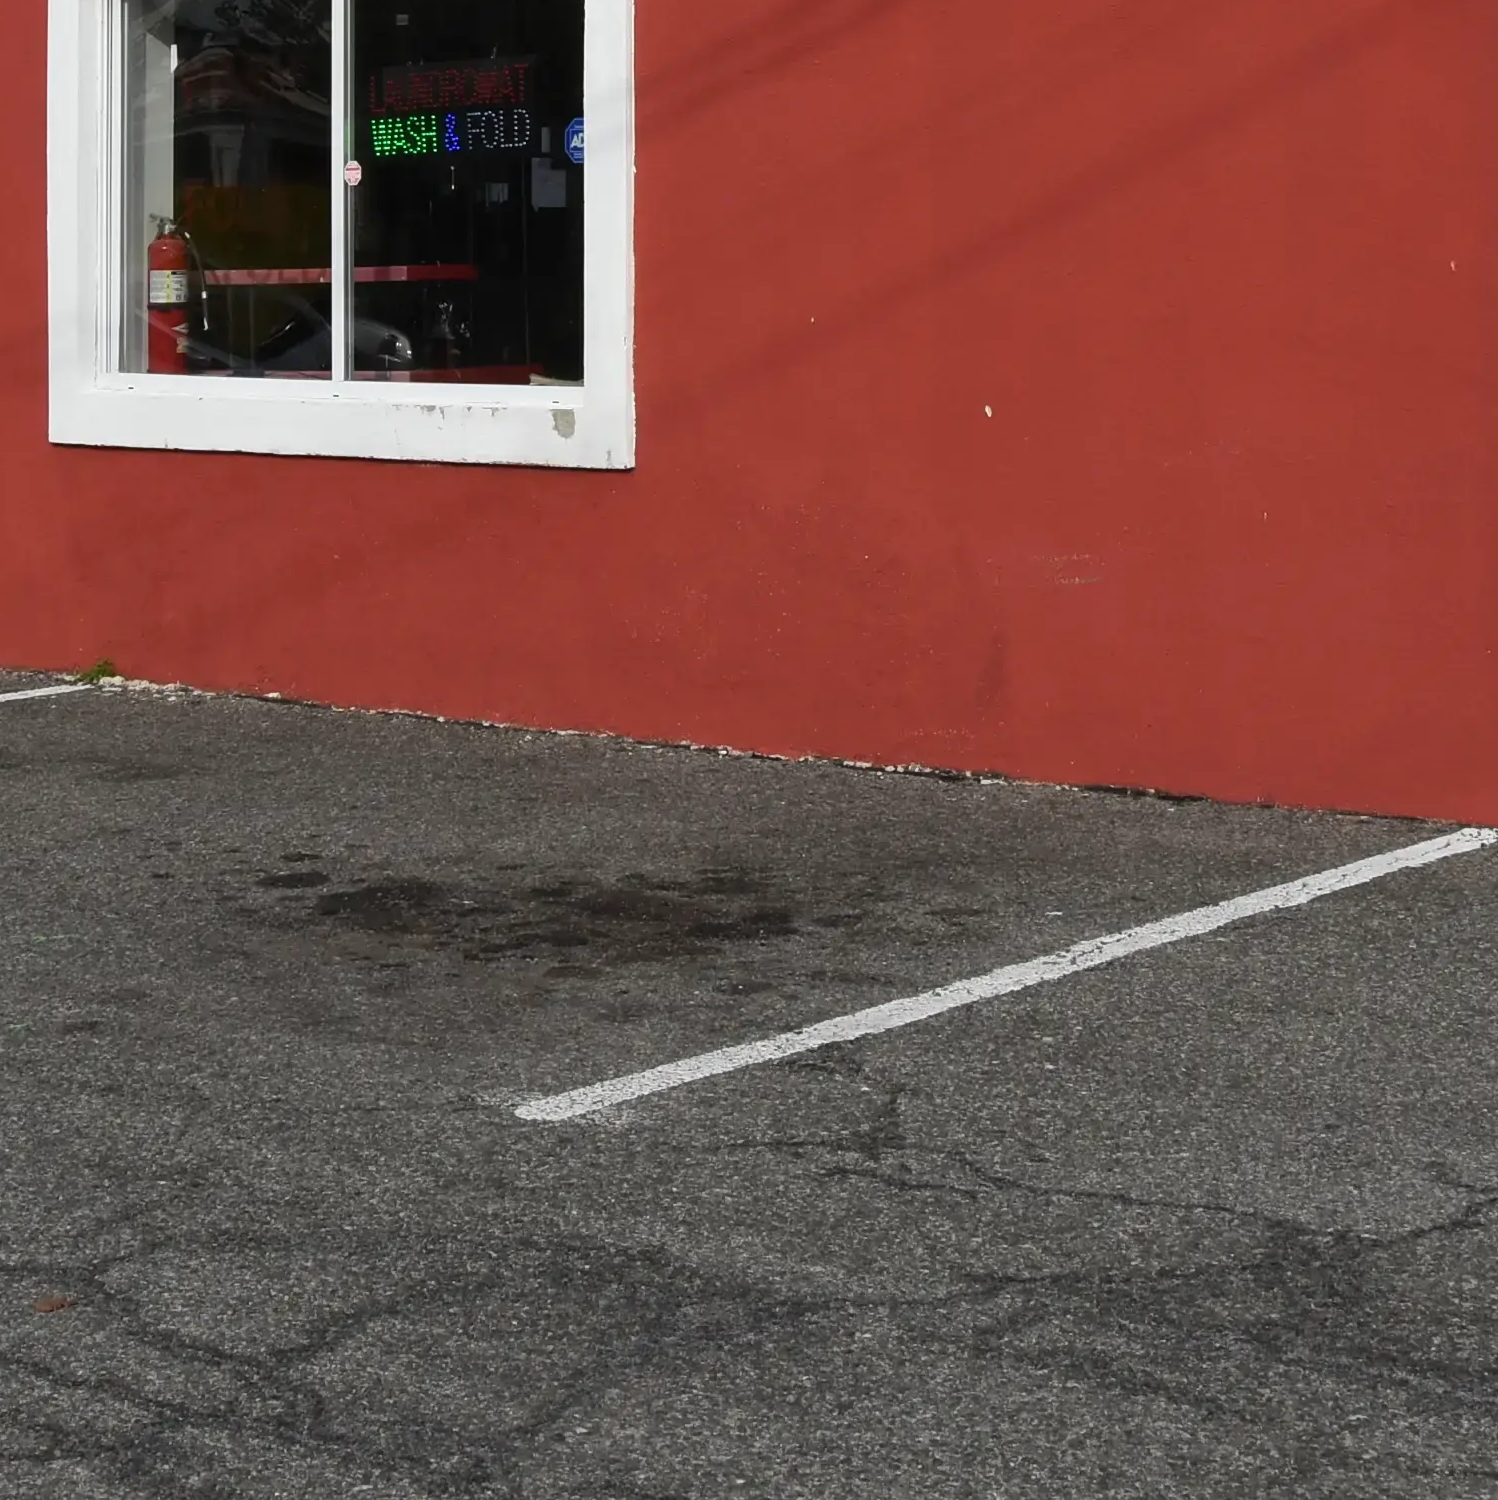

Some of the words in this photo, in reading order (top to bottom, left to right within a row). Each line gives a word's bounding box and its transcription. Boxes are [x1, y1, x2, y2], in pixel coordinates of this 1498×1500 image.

[371, 114, 437, 156] WASH
[445, 113, 460, 151] &
[466, 108, 530, 150] FOLD
[570, 132, 584, 148] AD
